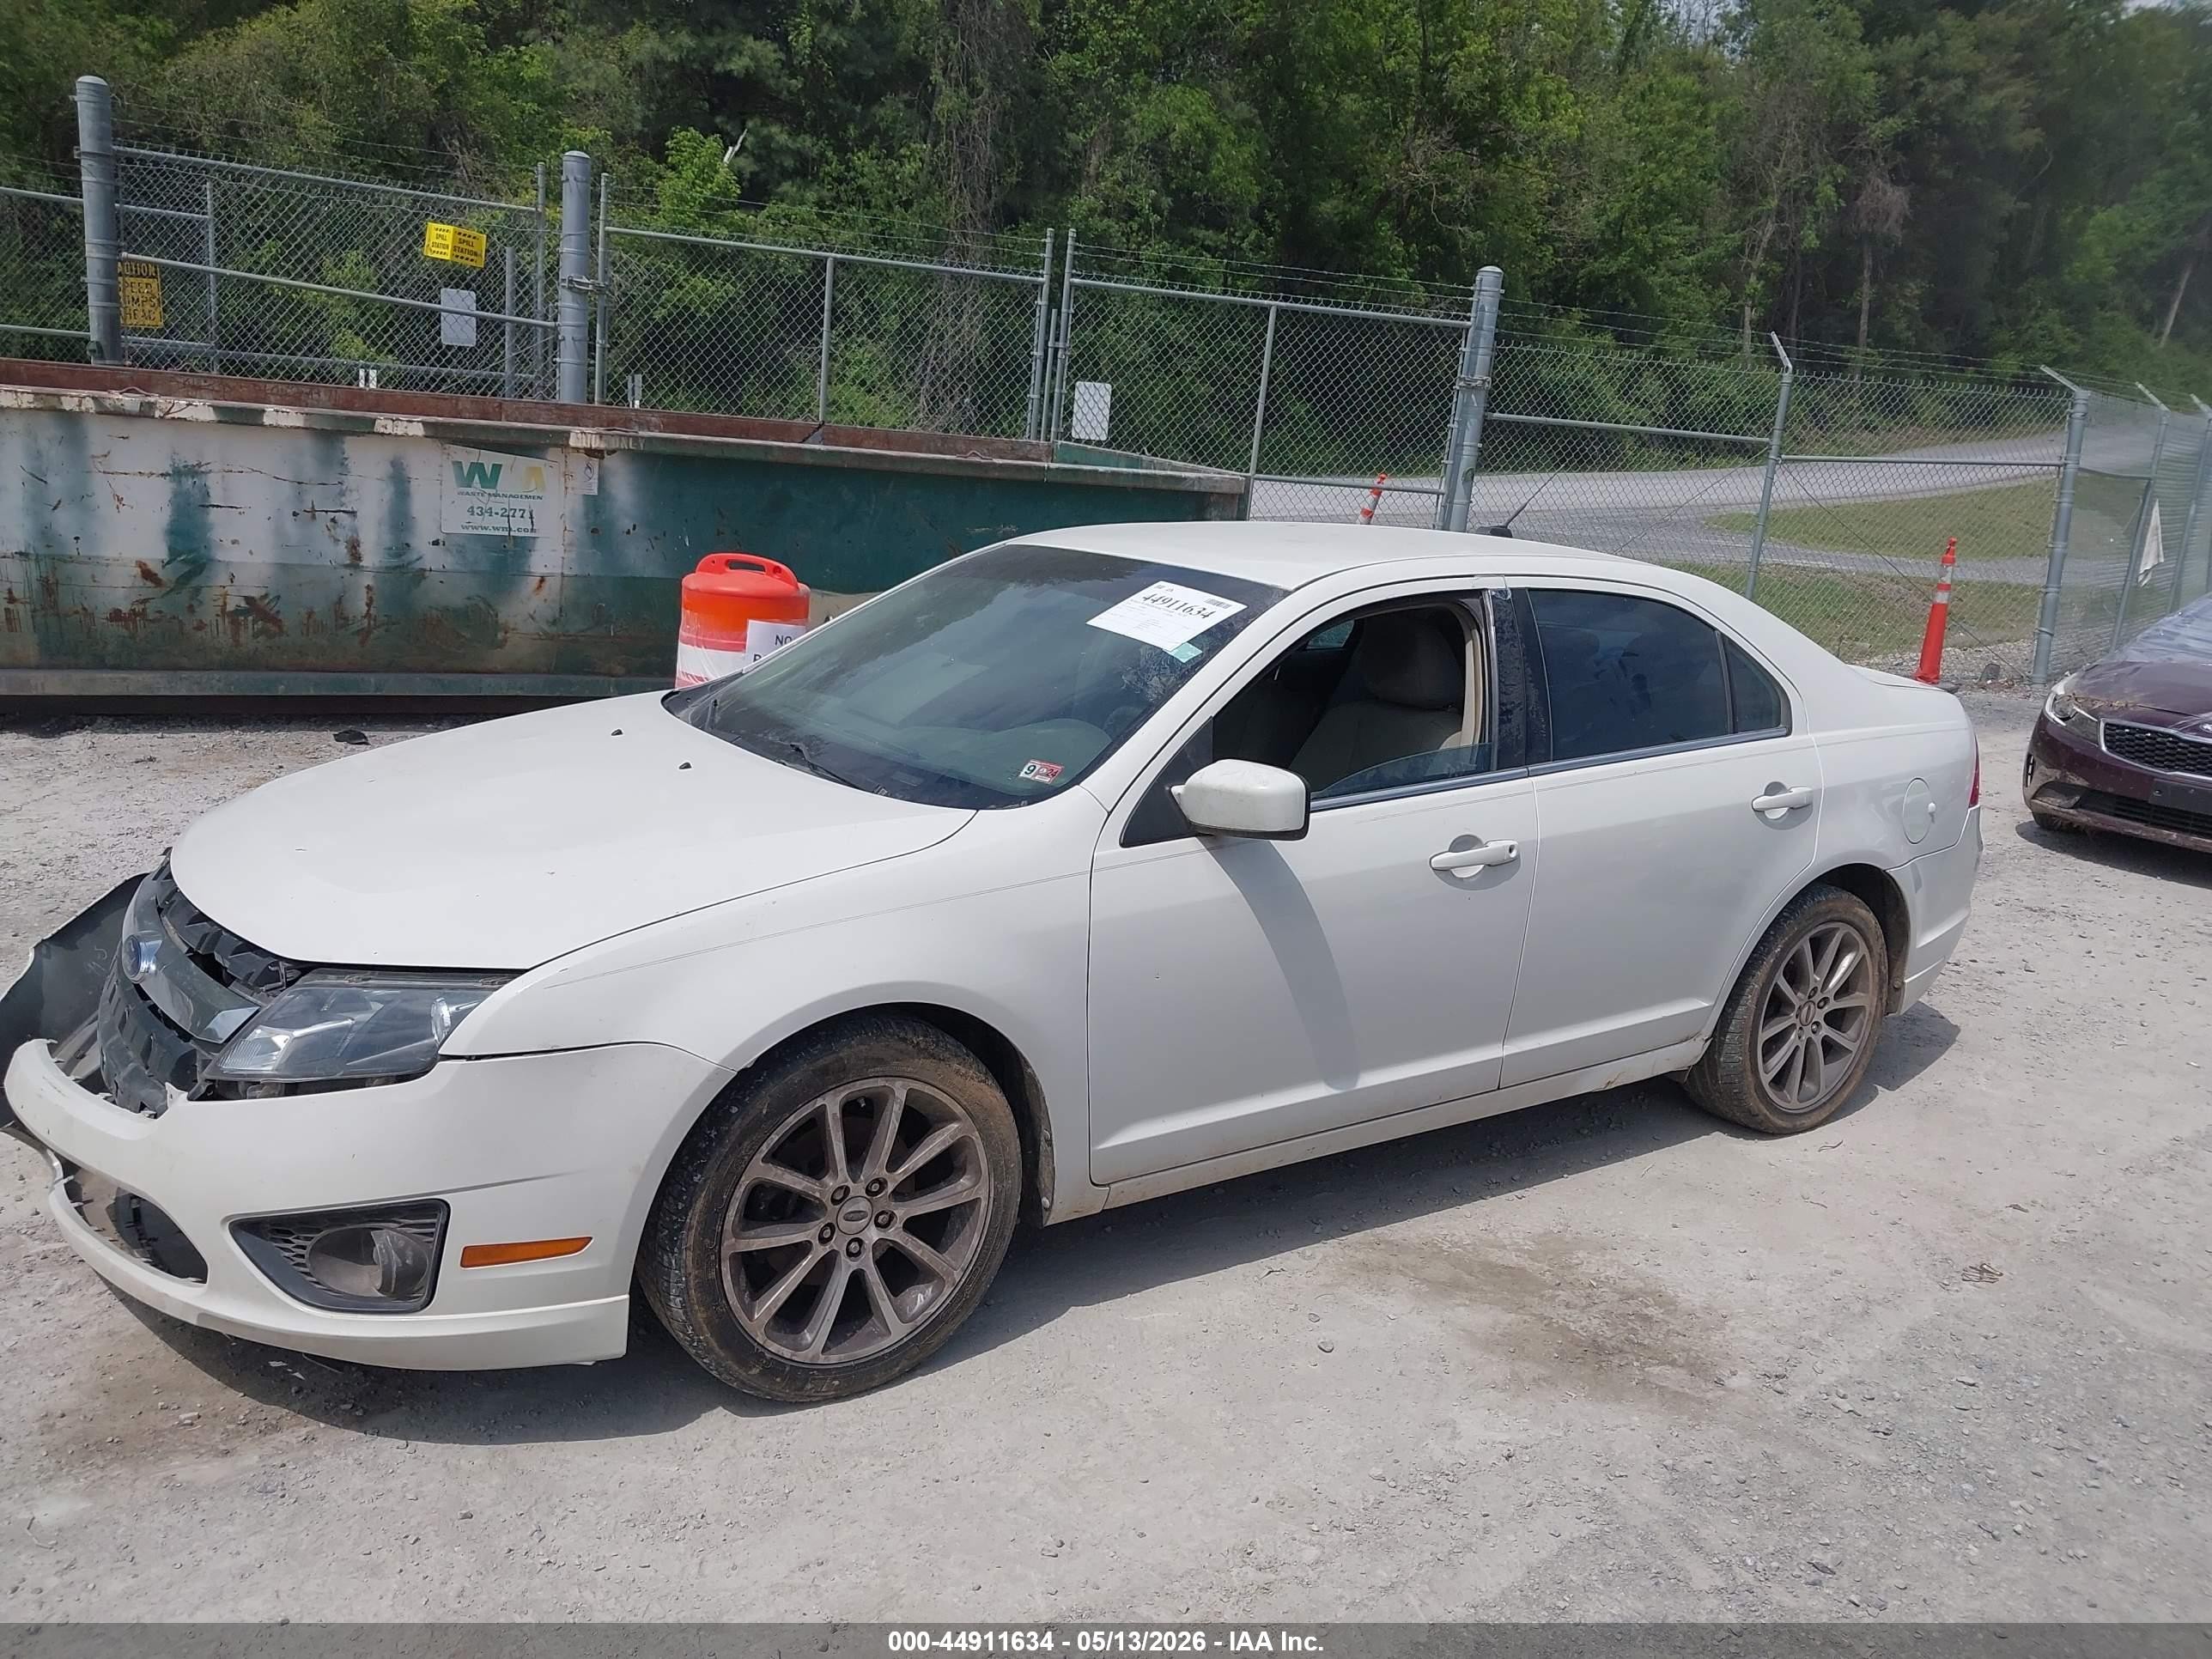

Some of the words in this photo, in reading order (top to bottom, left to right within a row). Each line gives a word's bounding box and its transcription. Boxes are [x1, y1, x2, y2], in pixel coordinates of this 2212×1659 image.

[435, 233, 447, 241] SPILL
[431, 241, 450, 250] STATION
[458, 238, 475, 248] SPILL
[453, 246, 478, 257] STATION
[121, 281, 154, 294] PEED
[122, 295, 157, 307] UMPS
[122, 308, 156, 321] HEAD
[1142, 592, 1216, 619] 44911634
[1024, 764, 1036, 775] 9
